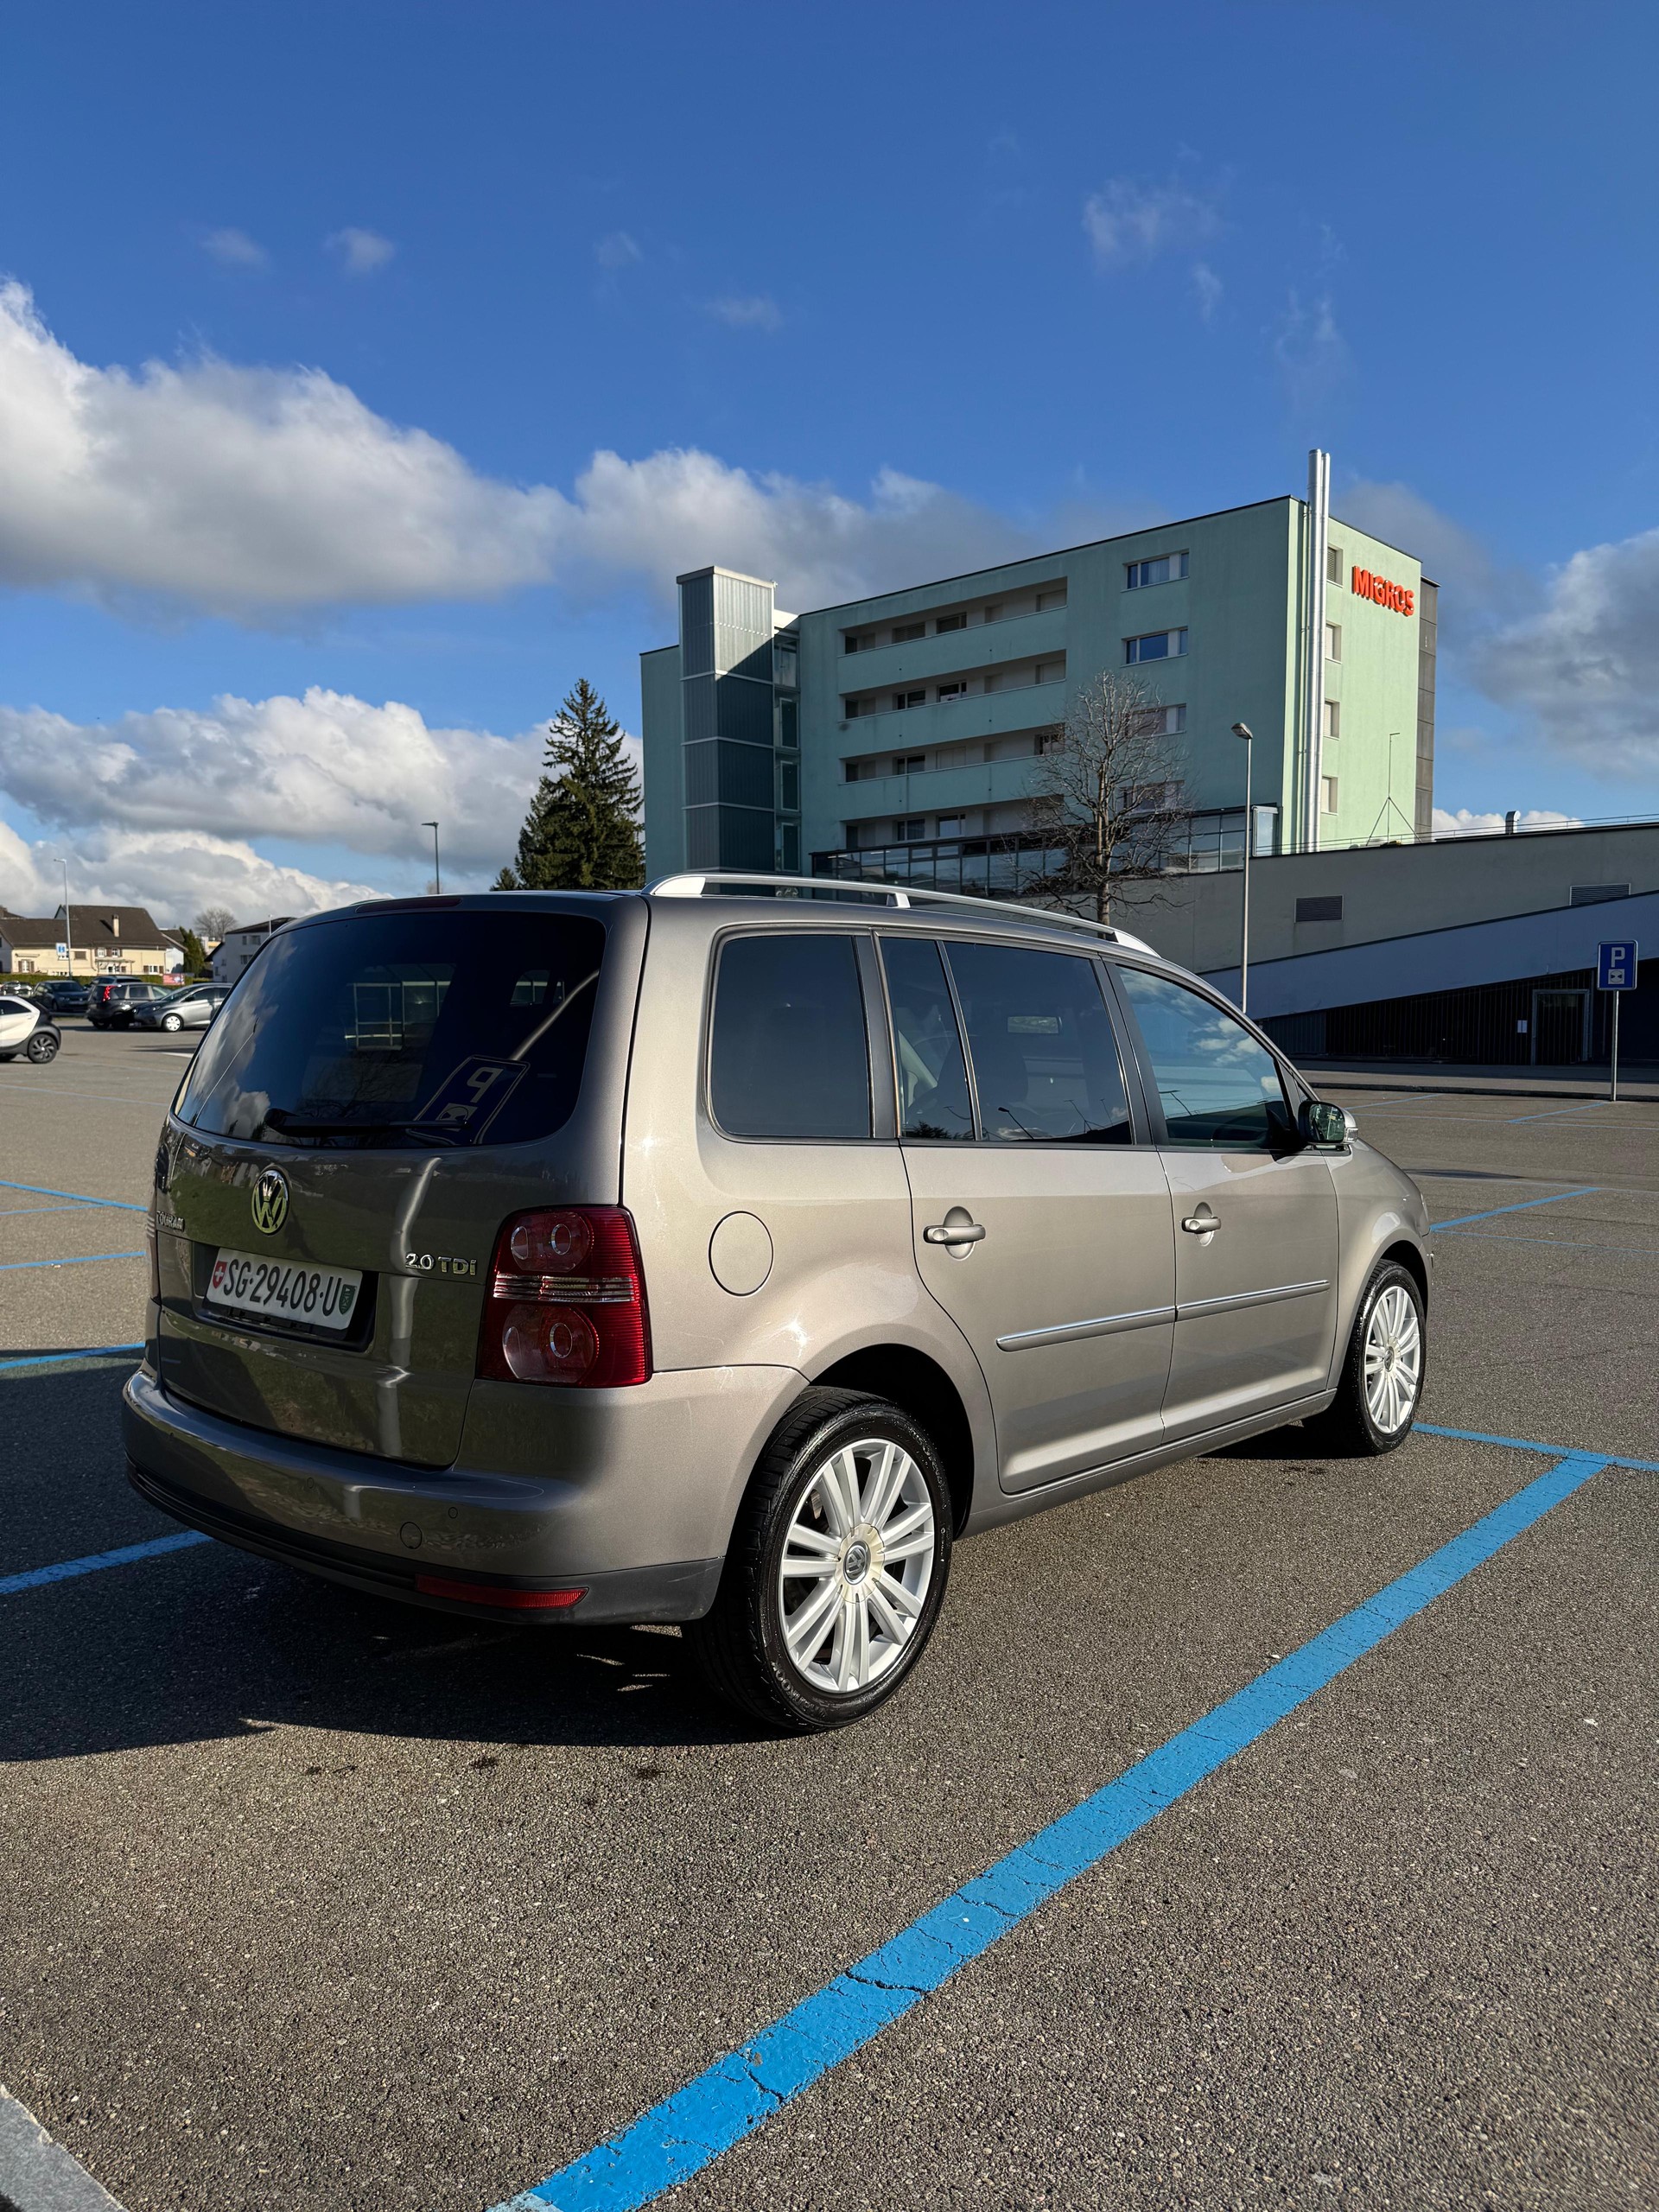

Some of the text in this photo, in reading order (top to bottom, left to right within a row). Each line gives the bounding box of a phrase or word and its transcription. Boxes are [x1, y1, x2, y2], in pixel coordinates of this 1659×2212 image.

[1351, 565, 1414, 617] MIGROS
[1611, 947, 1625, 968] P
[251, 1170, 289, 1234] VW
